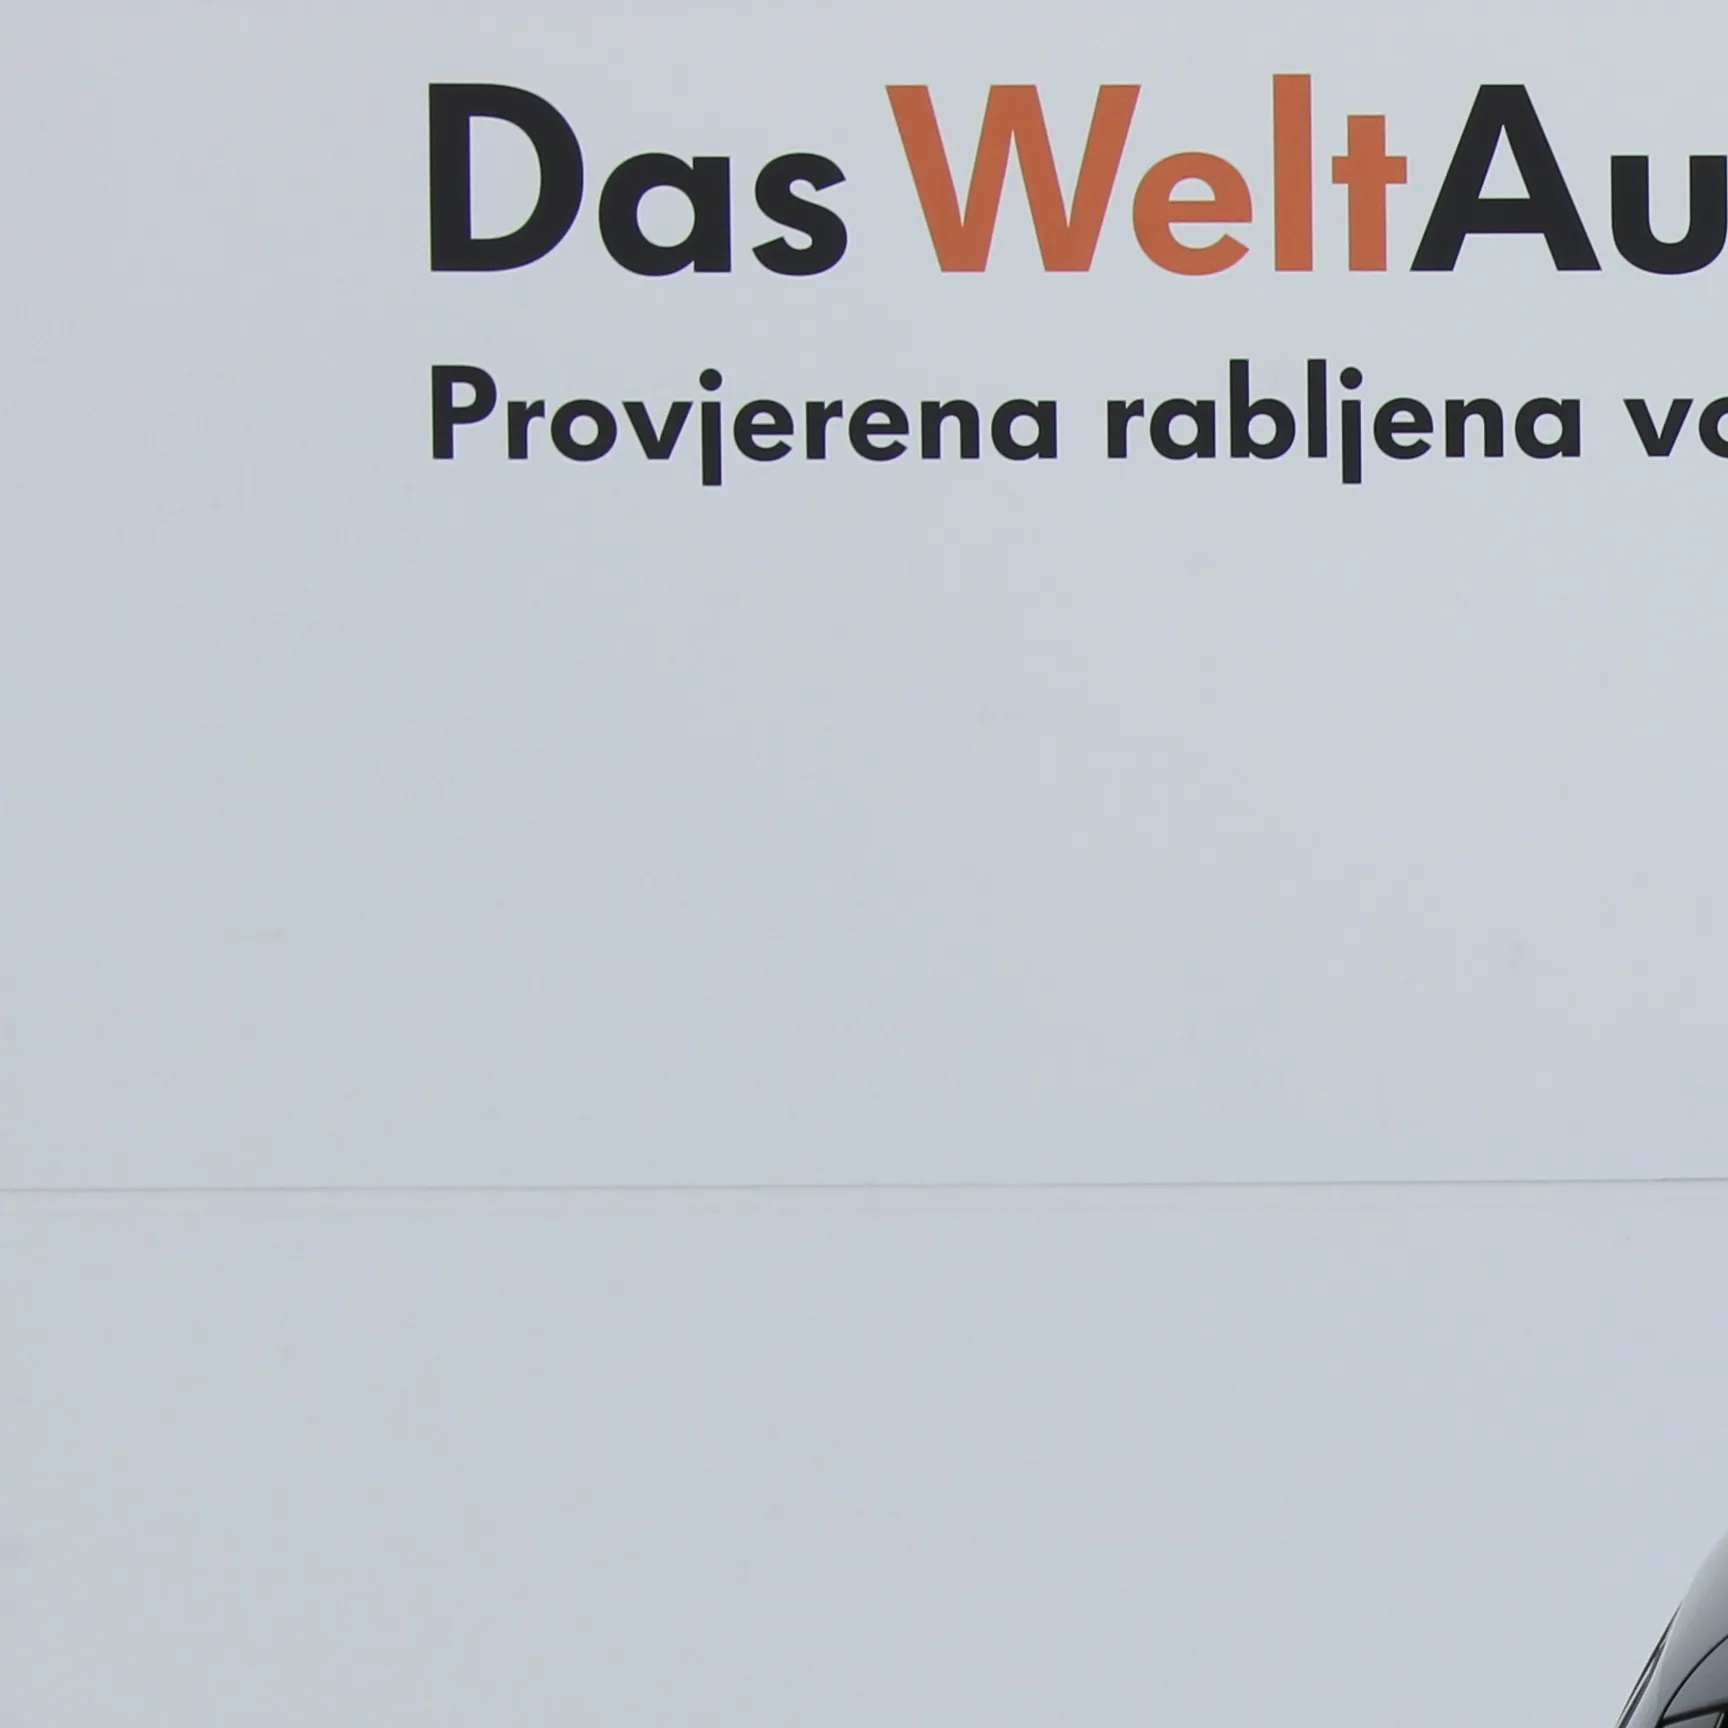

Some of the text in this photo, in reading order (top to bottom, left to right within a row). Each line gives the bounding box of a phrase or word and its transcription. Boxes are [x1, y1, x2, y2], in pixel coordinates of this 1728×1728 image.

[428, 82, 848, 277] Das
[431, 364, 1058, 487] Provjerena
[1106, 358, 1581, 485] rabljena
